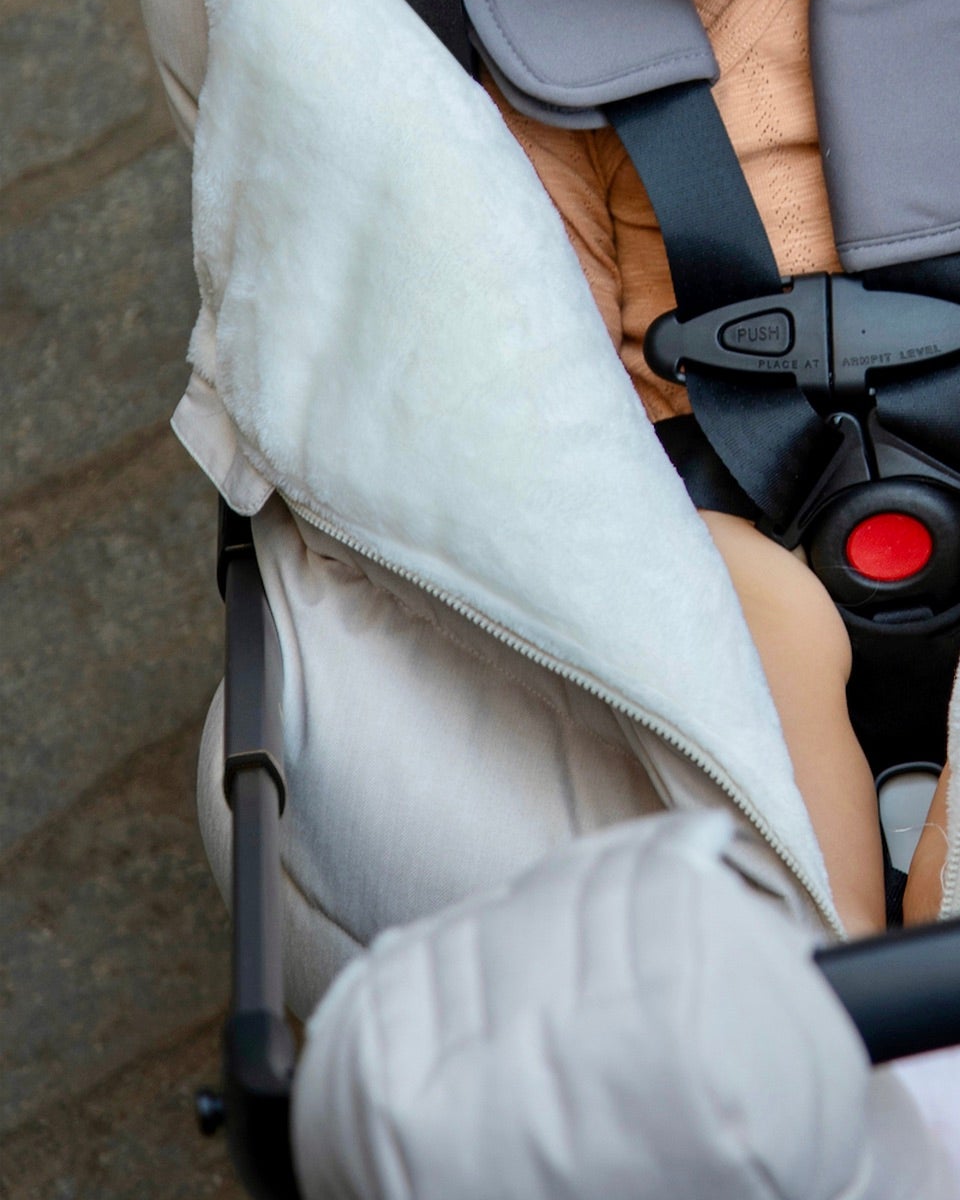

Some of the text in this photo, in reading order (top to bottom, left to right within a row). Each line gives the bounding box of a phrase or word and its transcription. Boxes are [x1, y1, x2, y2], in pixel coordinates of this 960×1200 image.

[737, 326, 780, 343] PUSH
[758, 344, 942, 370] PLACE AT ARMPIT LEVEL
